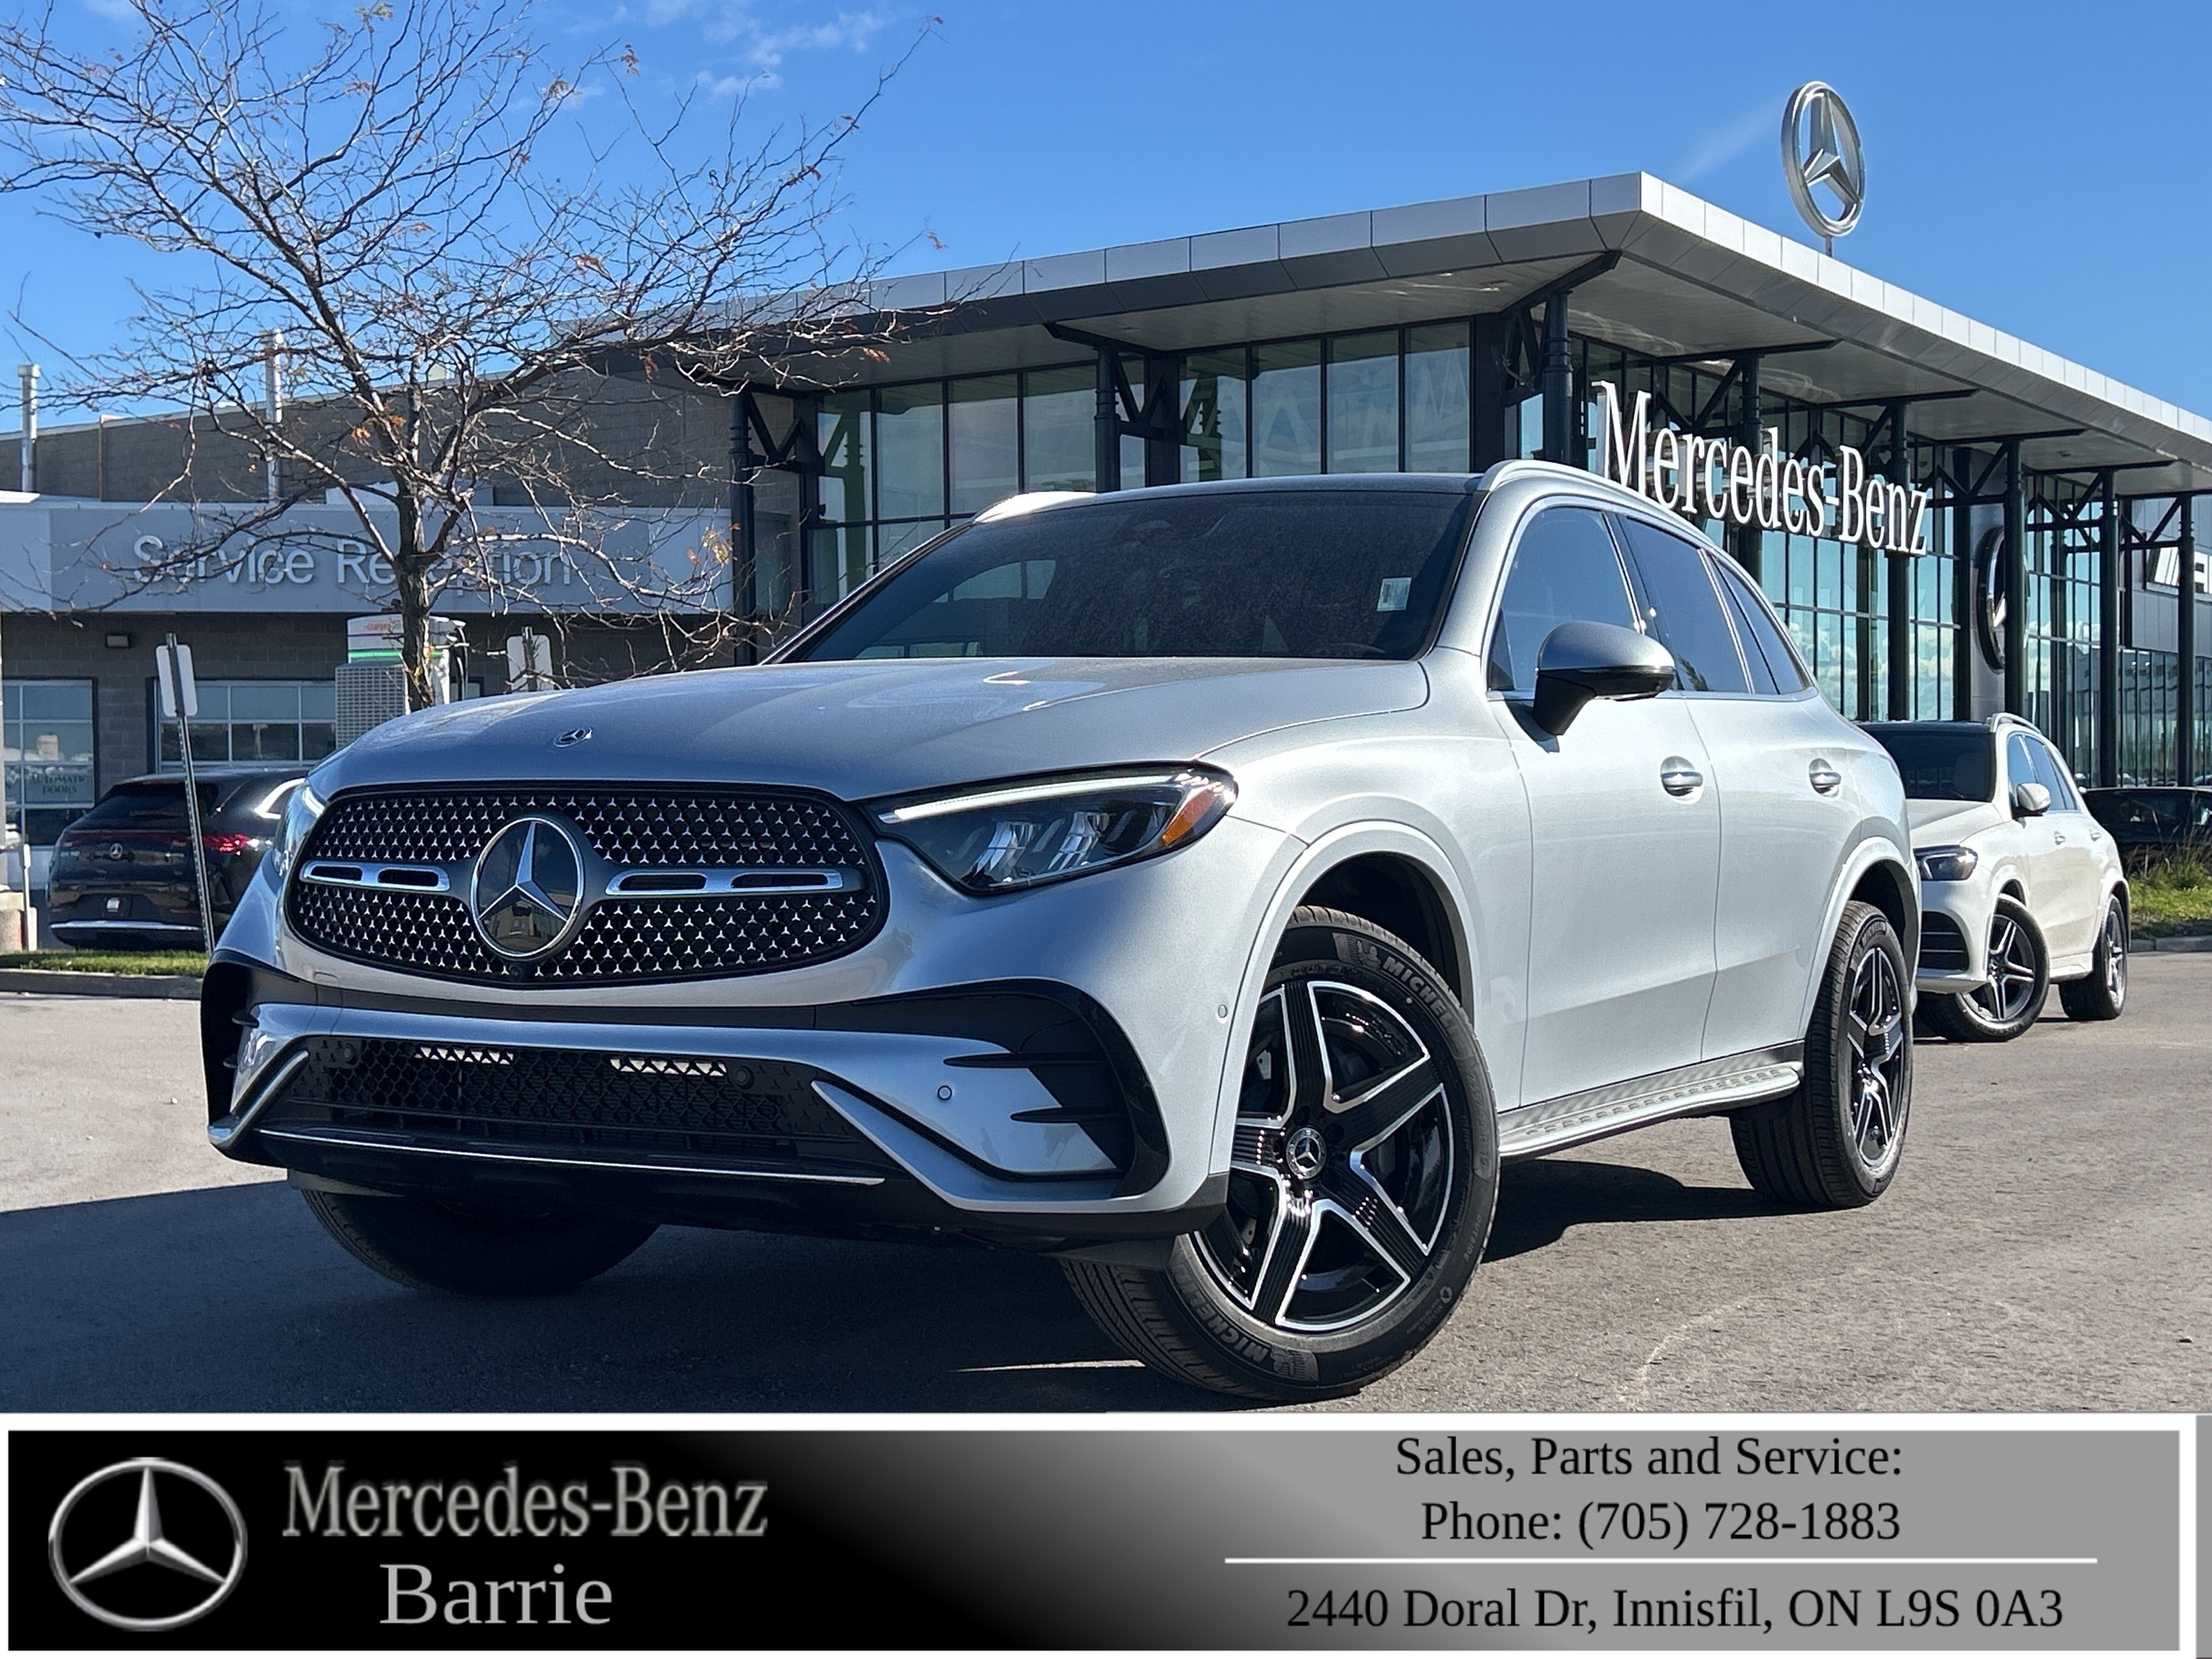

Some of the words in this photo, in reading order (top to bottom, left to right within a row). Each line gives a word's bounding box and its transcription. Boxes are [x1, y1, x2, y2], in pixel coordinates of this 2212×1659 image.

[1591, 380, 1927, 555] Mercedes-Benz
[134, 535, 315, 584] Service
[336, 537, 571, 596] Reetion
[1169, 1263, 1269, 1363] MICHELIN
